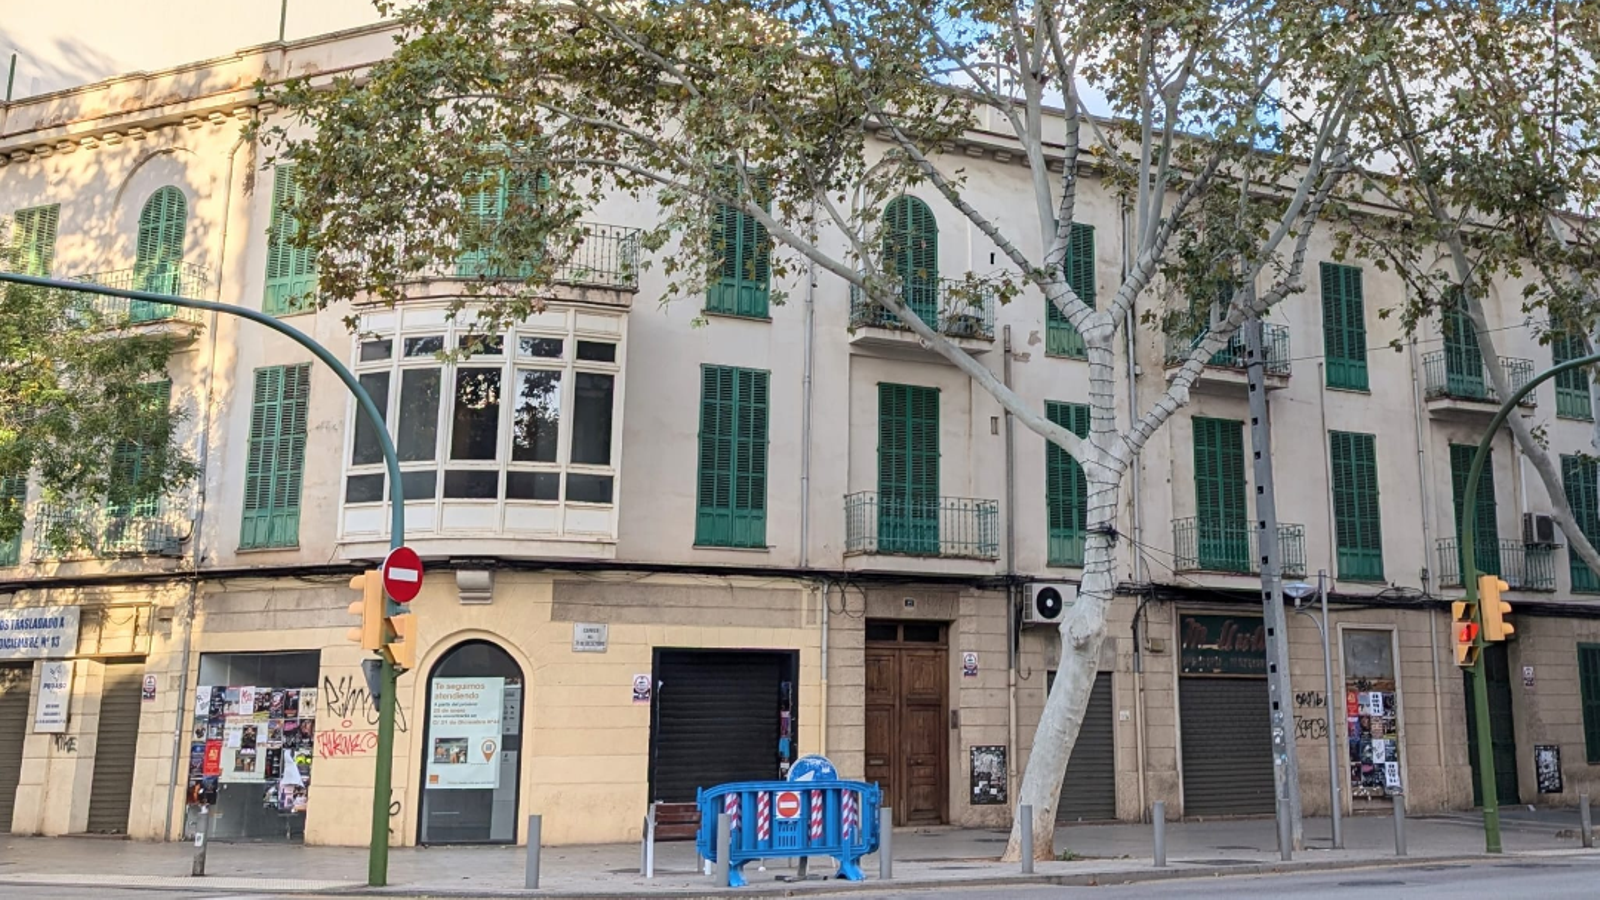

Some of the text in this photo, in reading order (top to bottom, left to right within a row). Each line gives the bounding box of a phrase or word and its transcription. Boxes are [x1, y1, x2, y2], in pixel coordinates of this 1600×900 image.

[11, 617, 59, 630] TRASLADADO
[59, 616, 65, 629] A
[446, 683, 485, 691] seguimos
[434, 692, 479, 700] atendiendo
